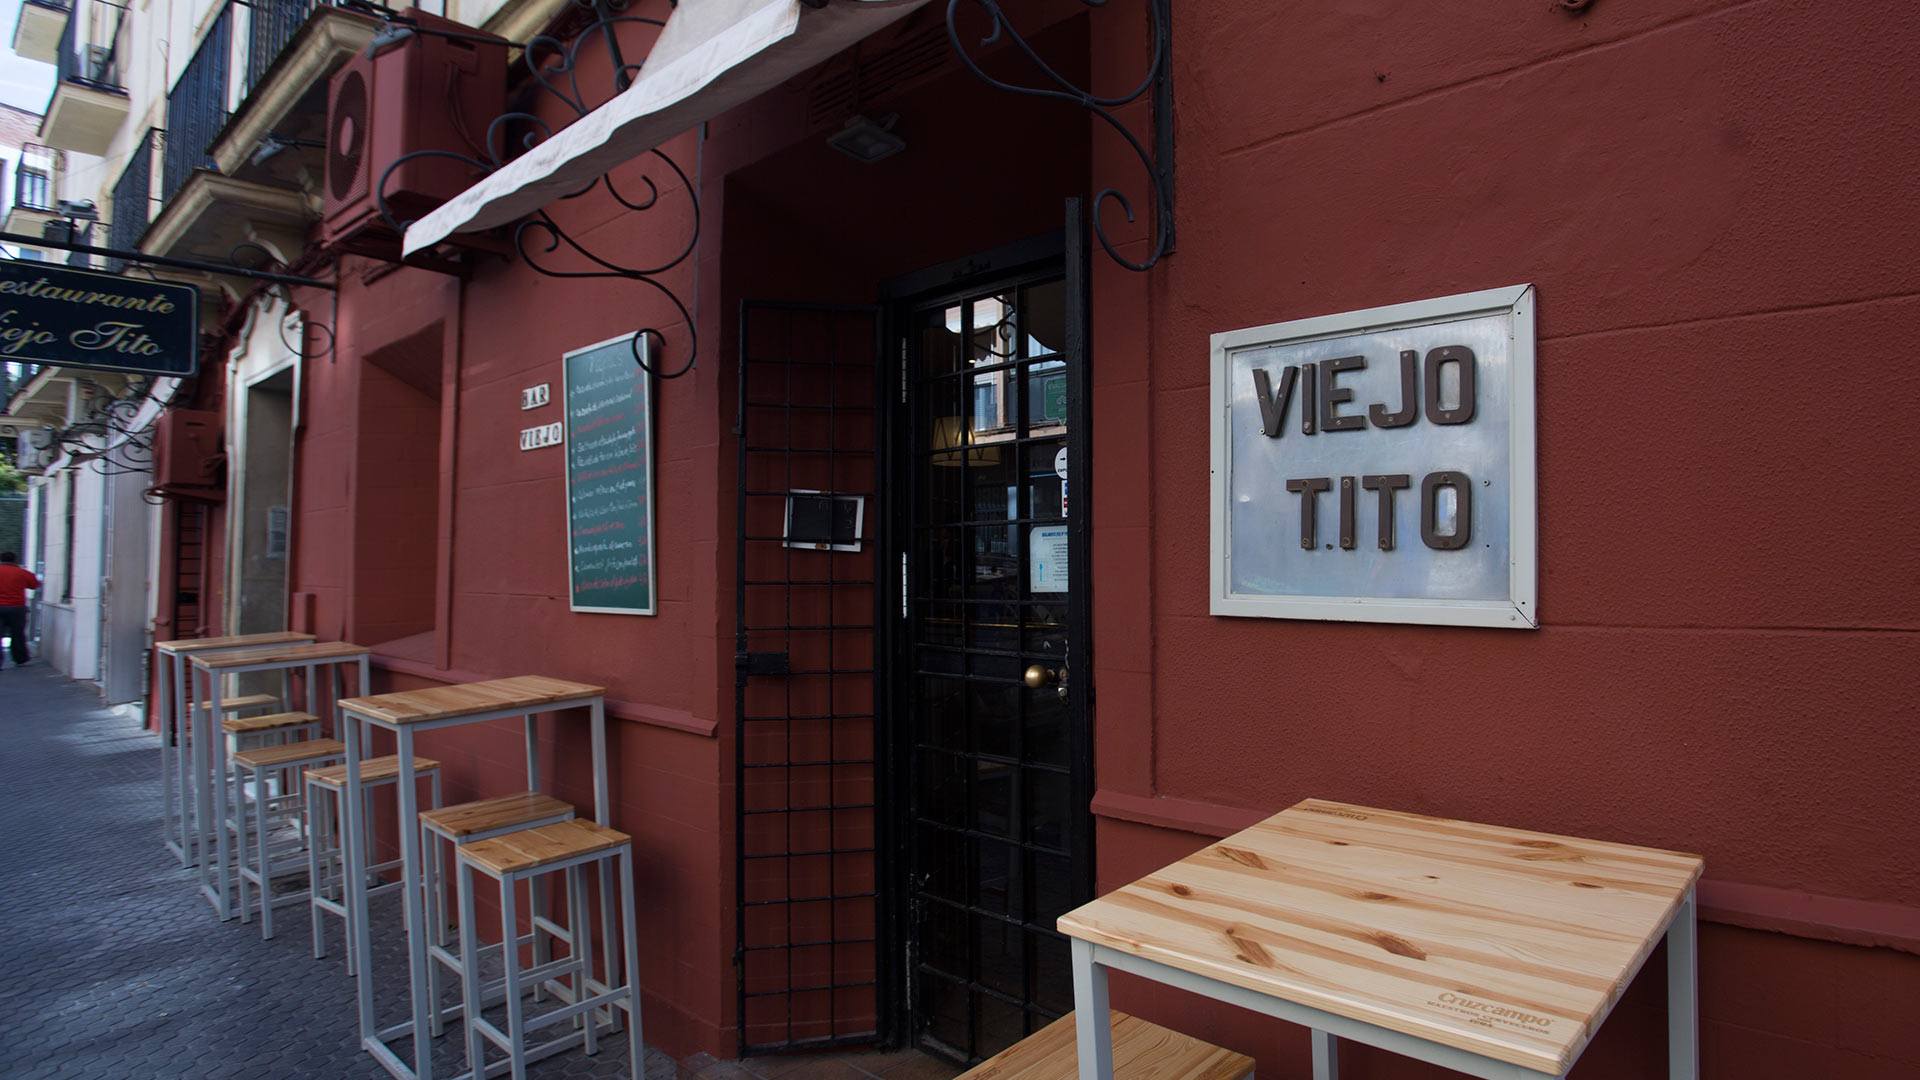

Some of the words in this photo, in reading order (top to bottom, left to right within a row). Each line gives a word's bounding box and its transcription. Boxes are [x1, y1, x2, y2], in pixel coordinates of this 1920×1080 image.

[0, 276, 176, 314] estaurante
[69, 321, 164, 356] Tito
[521, 386, 547, 408] BAR
[1252, 345, 1476, 438] VIEJO
[520, 425, 560, 448] VIEJO
[1286, 471, 1473, 551] TITO
[1438, 992, 1552, 1027] Cruzcampo
